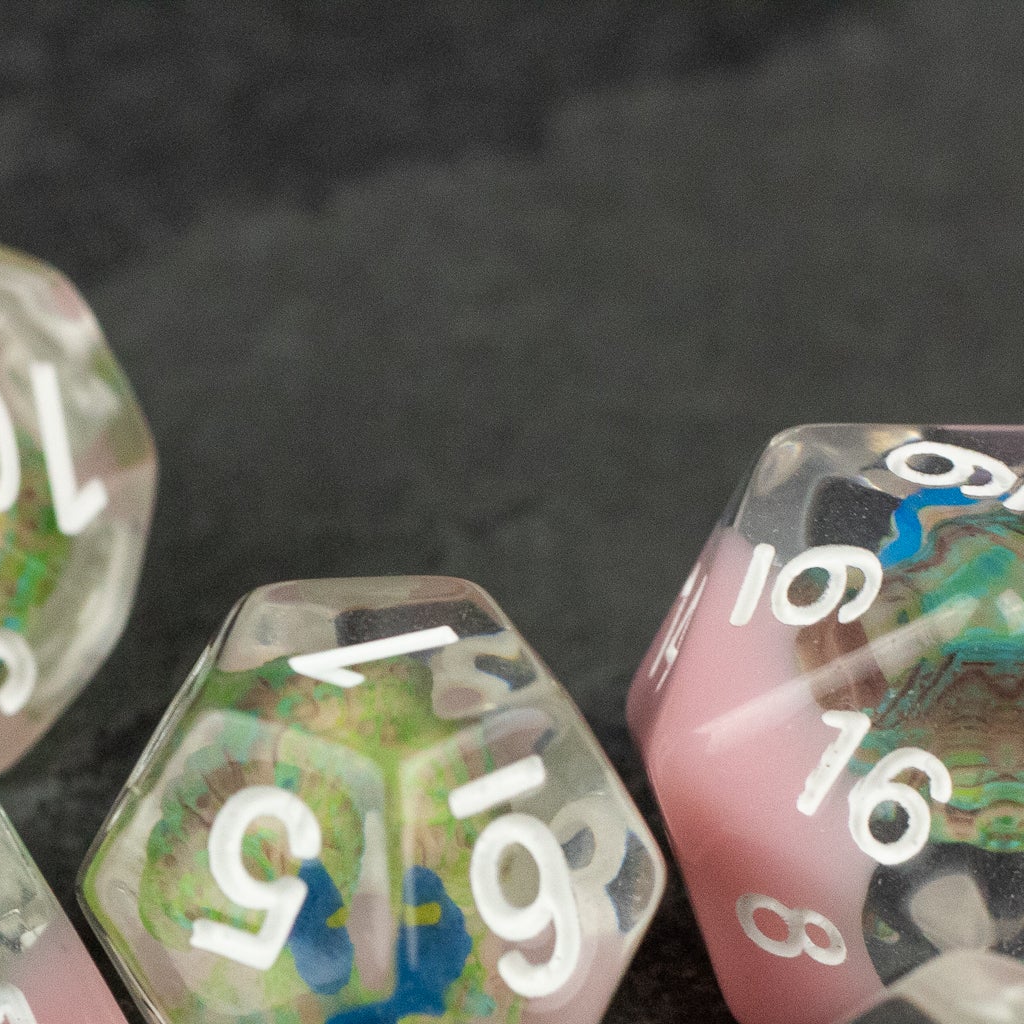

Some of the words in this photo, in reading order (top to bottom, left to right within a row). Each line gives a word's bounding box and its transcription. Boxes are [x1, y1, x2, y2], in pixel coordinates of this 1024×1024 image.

[797, 710, 953, 865] 16
[190, 785, 322, 971] 5
[736, 893, 847, 966] 8
